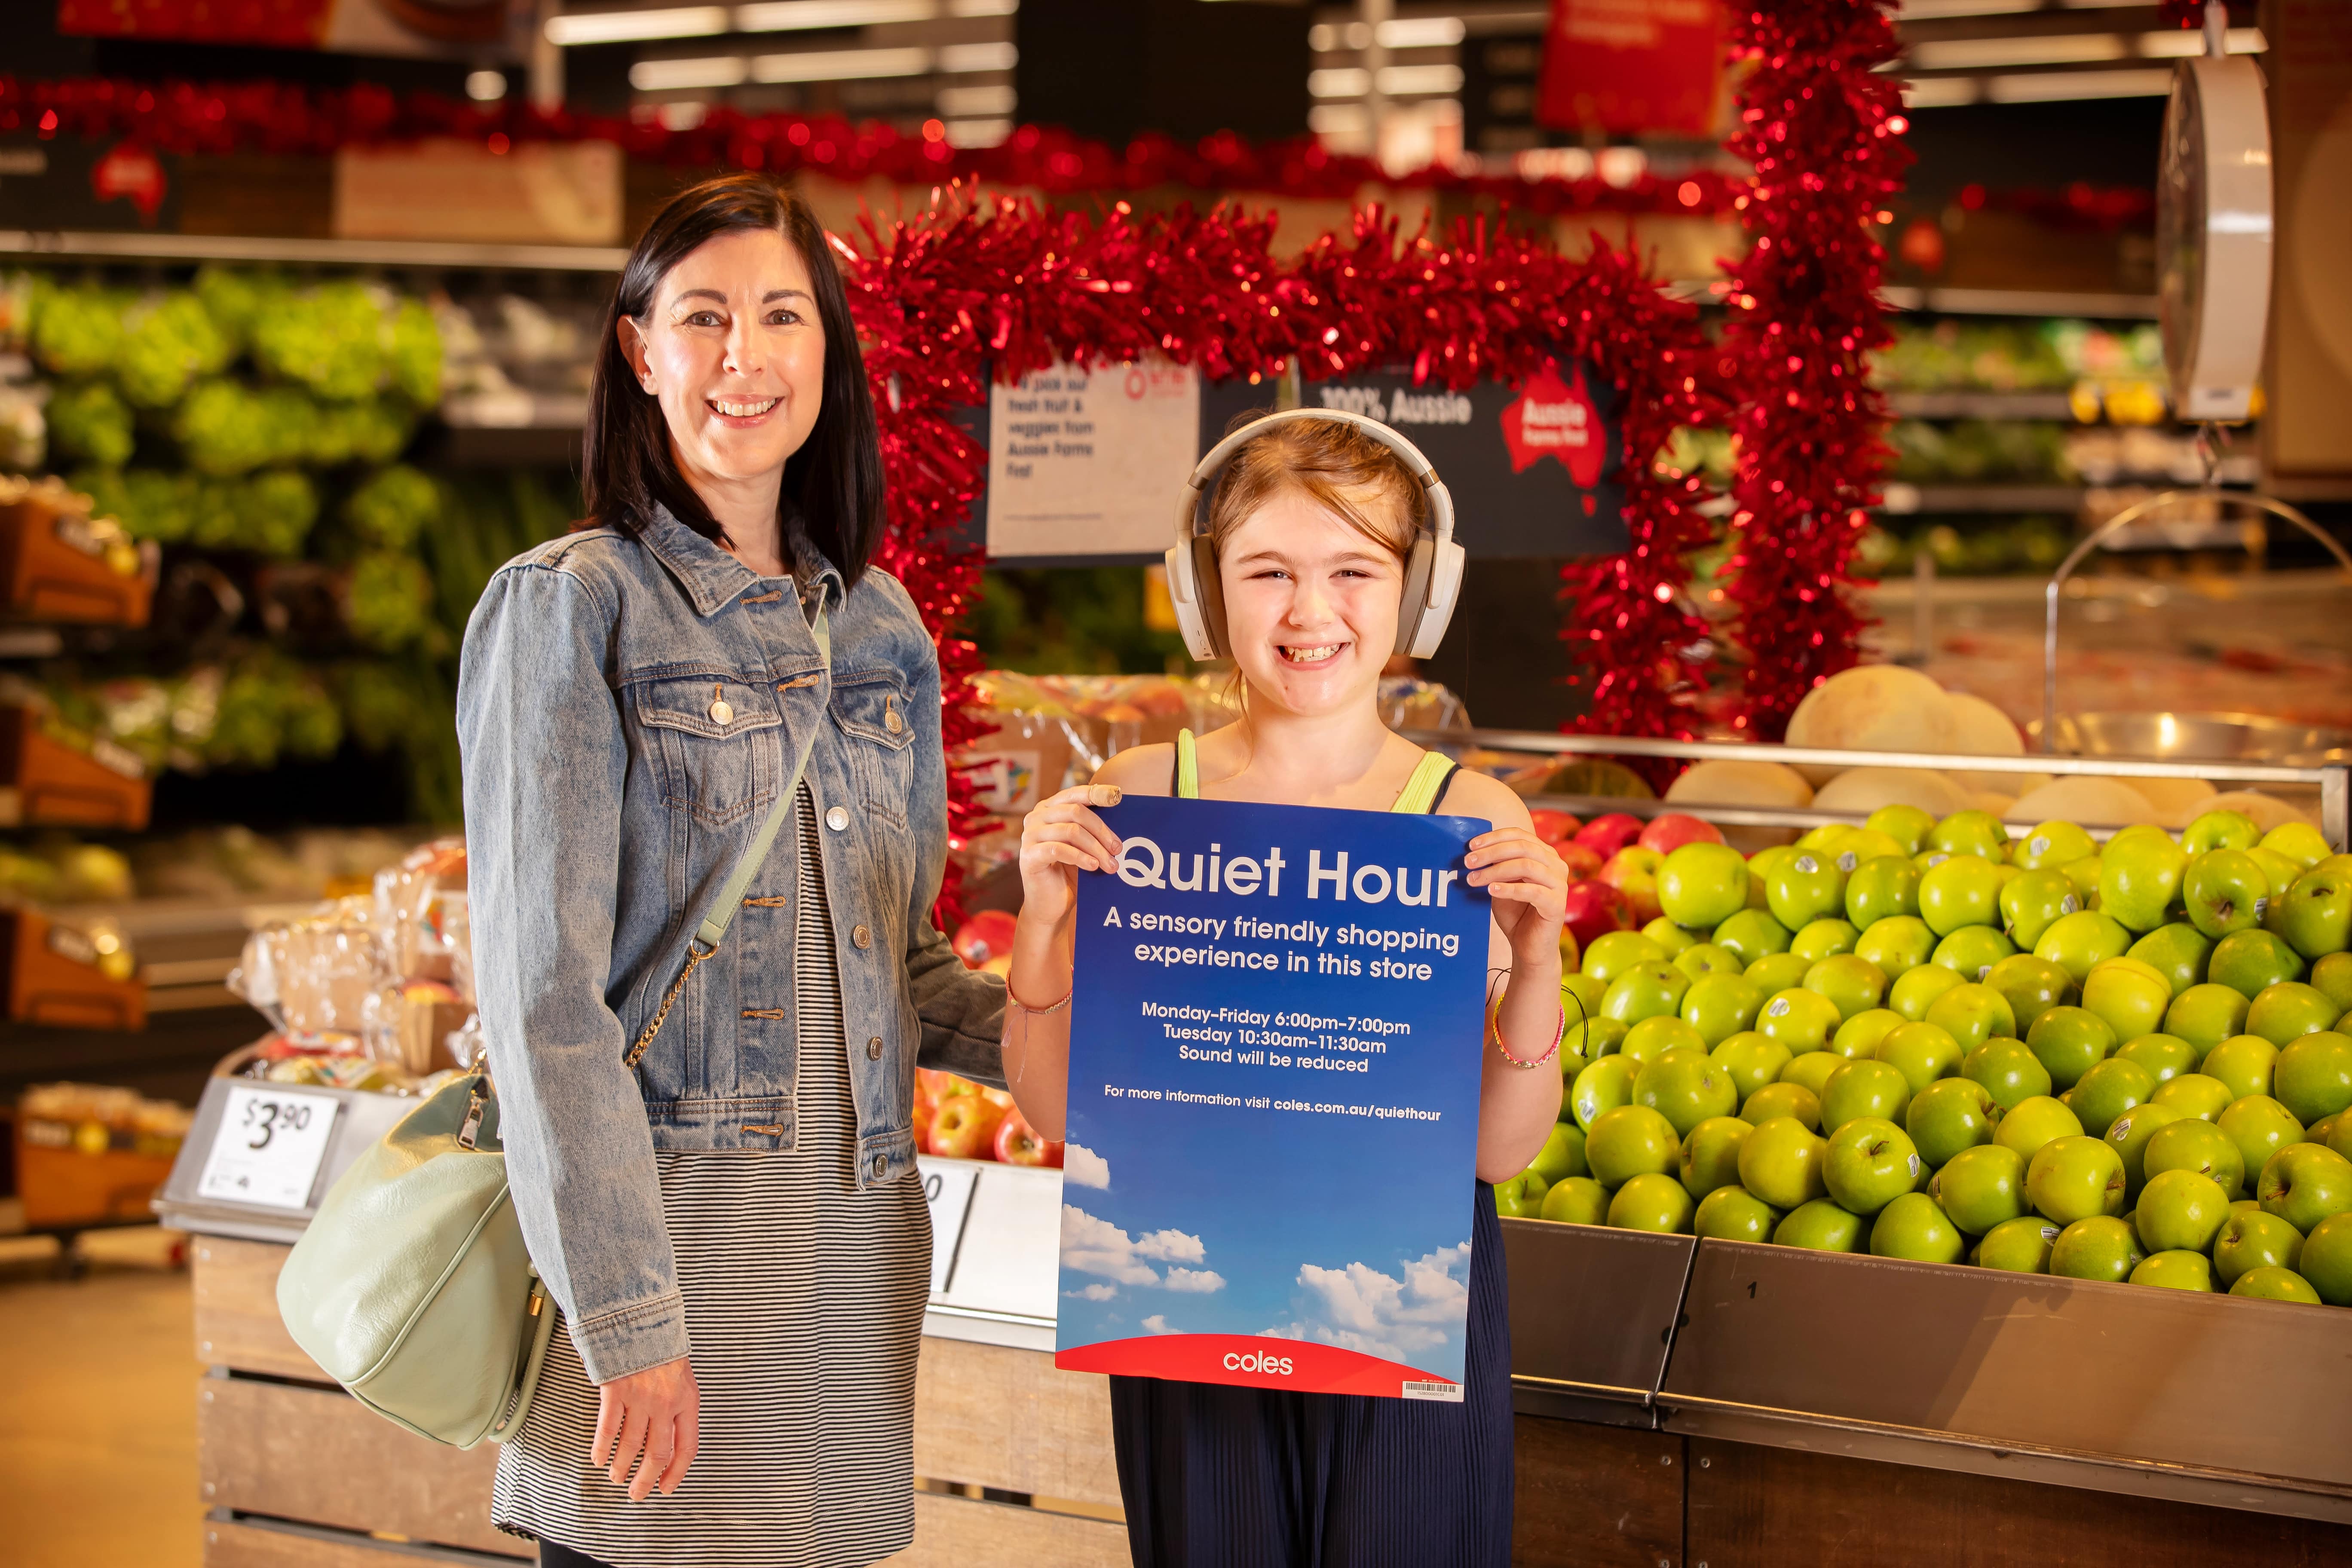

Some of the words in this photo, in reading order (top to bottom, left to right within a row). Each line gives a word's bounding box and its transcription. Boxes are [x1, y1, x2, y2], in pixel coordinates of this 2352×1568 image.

[1320, 387, 1387, 422] 100%
[1389, 387, 1473, 425] Aussie
[1522, 396, 1587, 426] Aussie
[1116, 836, 1286, 896] Quiet
[1308, 850, 1458, 907] Hour
[1103, 906, 1122, 928] A
[1130, 913, 1226, 940] sensory
[1234, 916, 1329, 947] friendly
[1337, 925, 1459, 957] shopping
[1135, 943, 1278, 970] experience
[1288, 951, 1308, 972] in
[1318, 953, 1361, 976] this
[1370, 957, 1432, 980] store
[1164, 1024, 1232, 1045] Tuesday
[1179, 1045, 1232, 1063] Sound
[1237, 1050, 1264, 1065] will
[1270, 1052, 1291, 1067] be
[1297, 1056, 1368, 1072] reduced
[1105, 1084, 1124, 1097] For
[1128, 1089, 1161, 1100] more
[1166, 1090, 1240, 1106] information
[1245, 1096, 1270, 1109] visit
[1274, 1099, 1441, 1121] coles.com.au/quiethour
[1747, 1281, 1757, 1298] 1
[1223, 1351, 1292, 1375] coles
